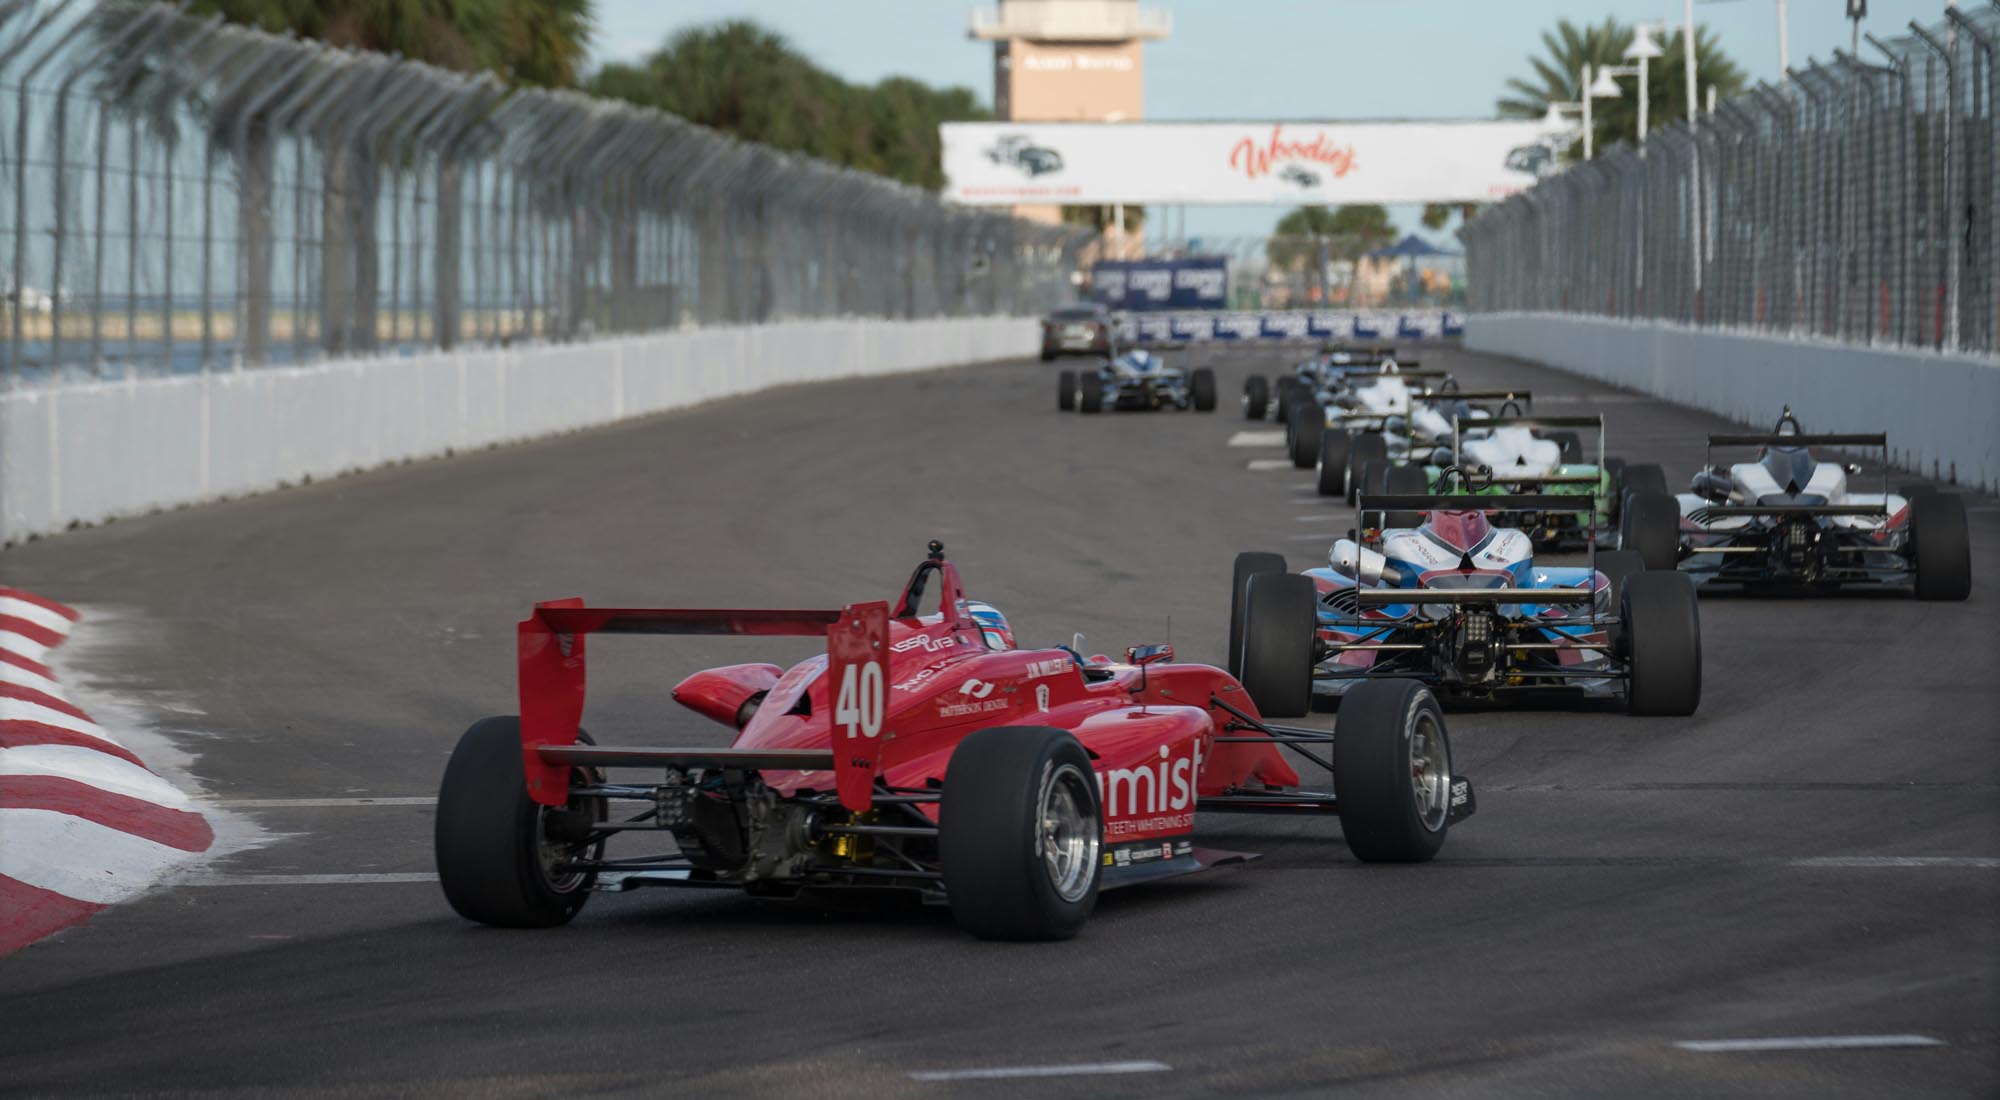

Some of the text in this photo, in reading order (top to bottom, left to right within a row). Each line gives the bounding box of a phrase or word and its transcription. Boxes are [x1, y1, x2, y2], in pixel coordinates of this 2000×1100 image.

[835, 661, 883, 738] 40
[1095, 738, 1203, 817] mist
[1107, 820, 1136, 835] TEETH
[1137, 815, 1182, 832] WHITENING
